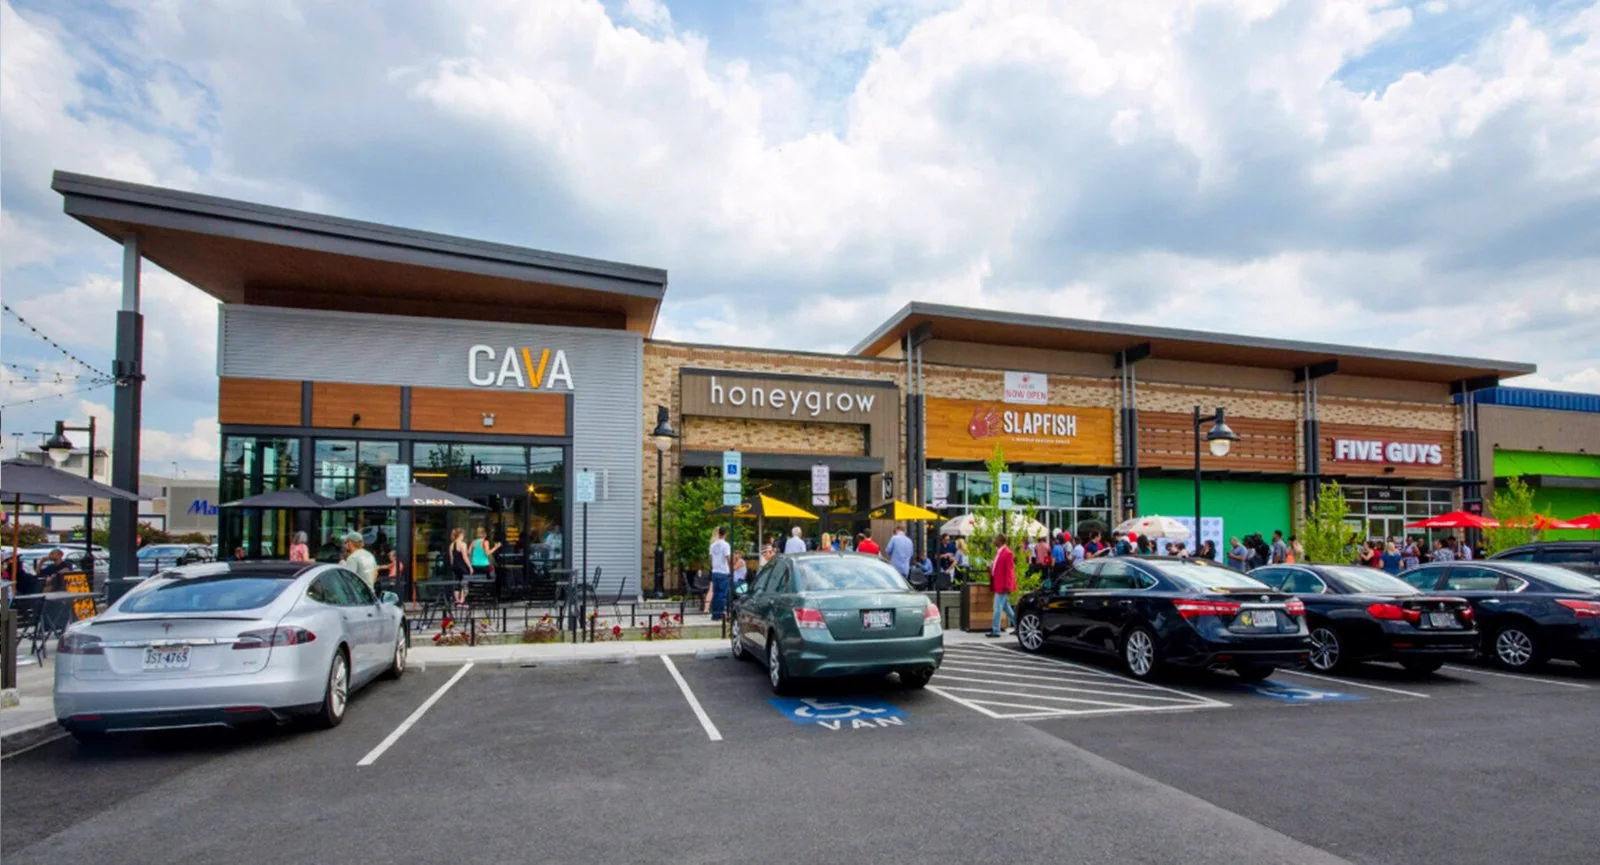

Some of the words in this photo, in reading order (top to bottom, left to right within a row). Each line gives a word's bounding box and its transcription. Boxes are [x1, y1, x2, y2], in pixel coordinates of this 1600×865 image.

[468, 344, 575, 389] CAVA
[710, 376, 875, 416] honeygrow
[1006, 389, 1026, 399] NOW
[1027, 390, 1047, 401] OPEN
[1003, 410, 1077, 436] SLAPFISH
[1334, 439, 1383, 461] FIVE
[1385, 442, 1442, 465] GUYS
[817, 716, 906, 731] VAN
